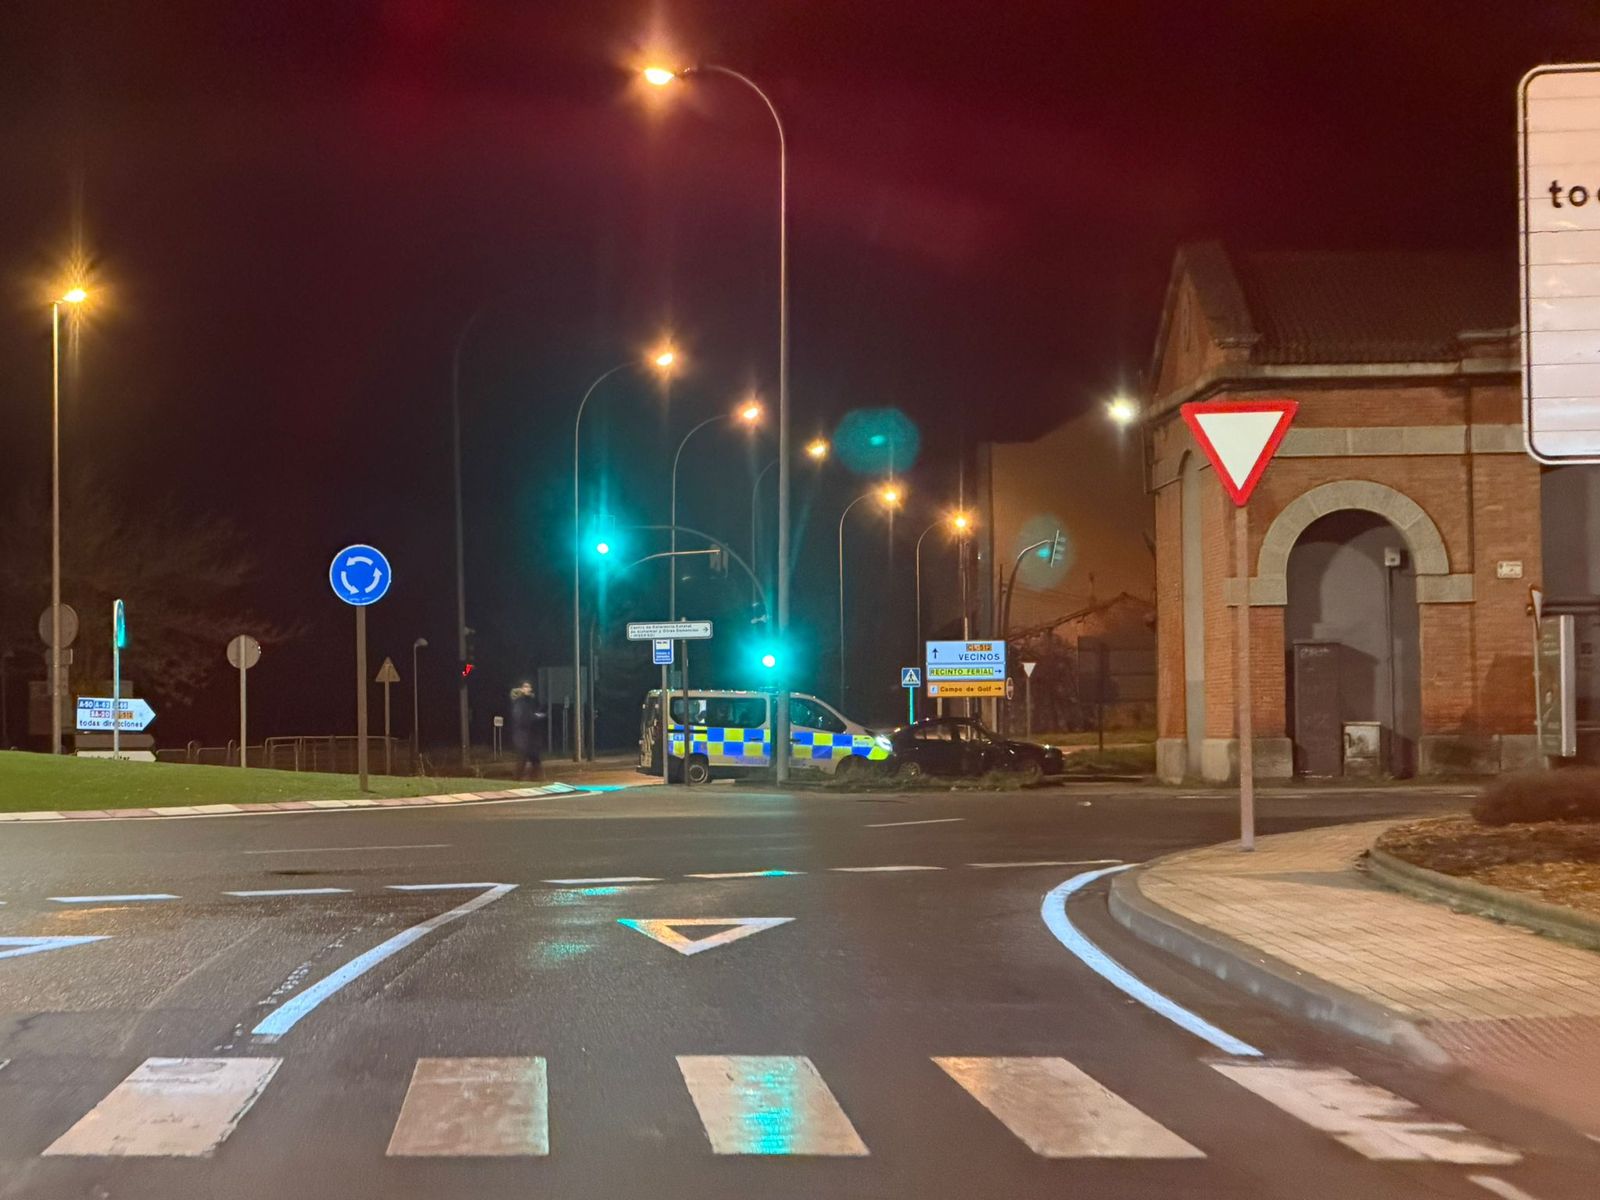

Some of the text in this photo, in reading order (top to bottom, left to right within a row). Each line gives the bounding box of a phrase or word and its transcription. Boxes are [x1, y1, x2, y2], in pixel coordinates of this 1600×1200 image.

[1548, 180, 1600, 209] to
[958, 653, 1000, 661] VECINOS
[967, 667, 993, 675] FERIAL
